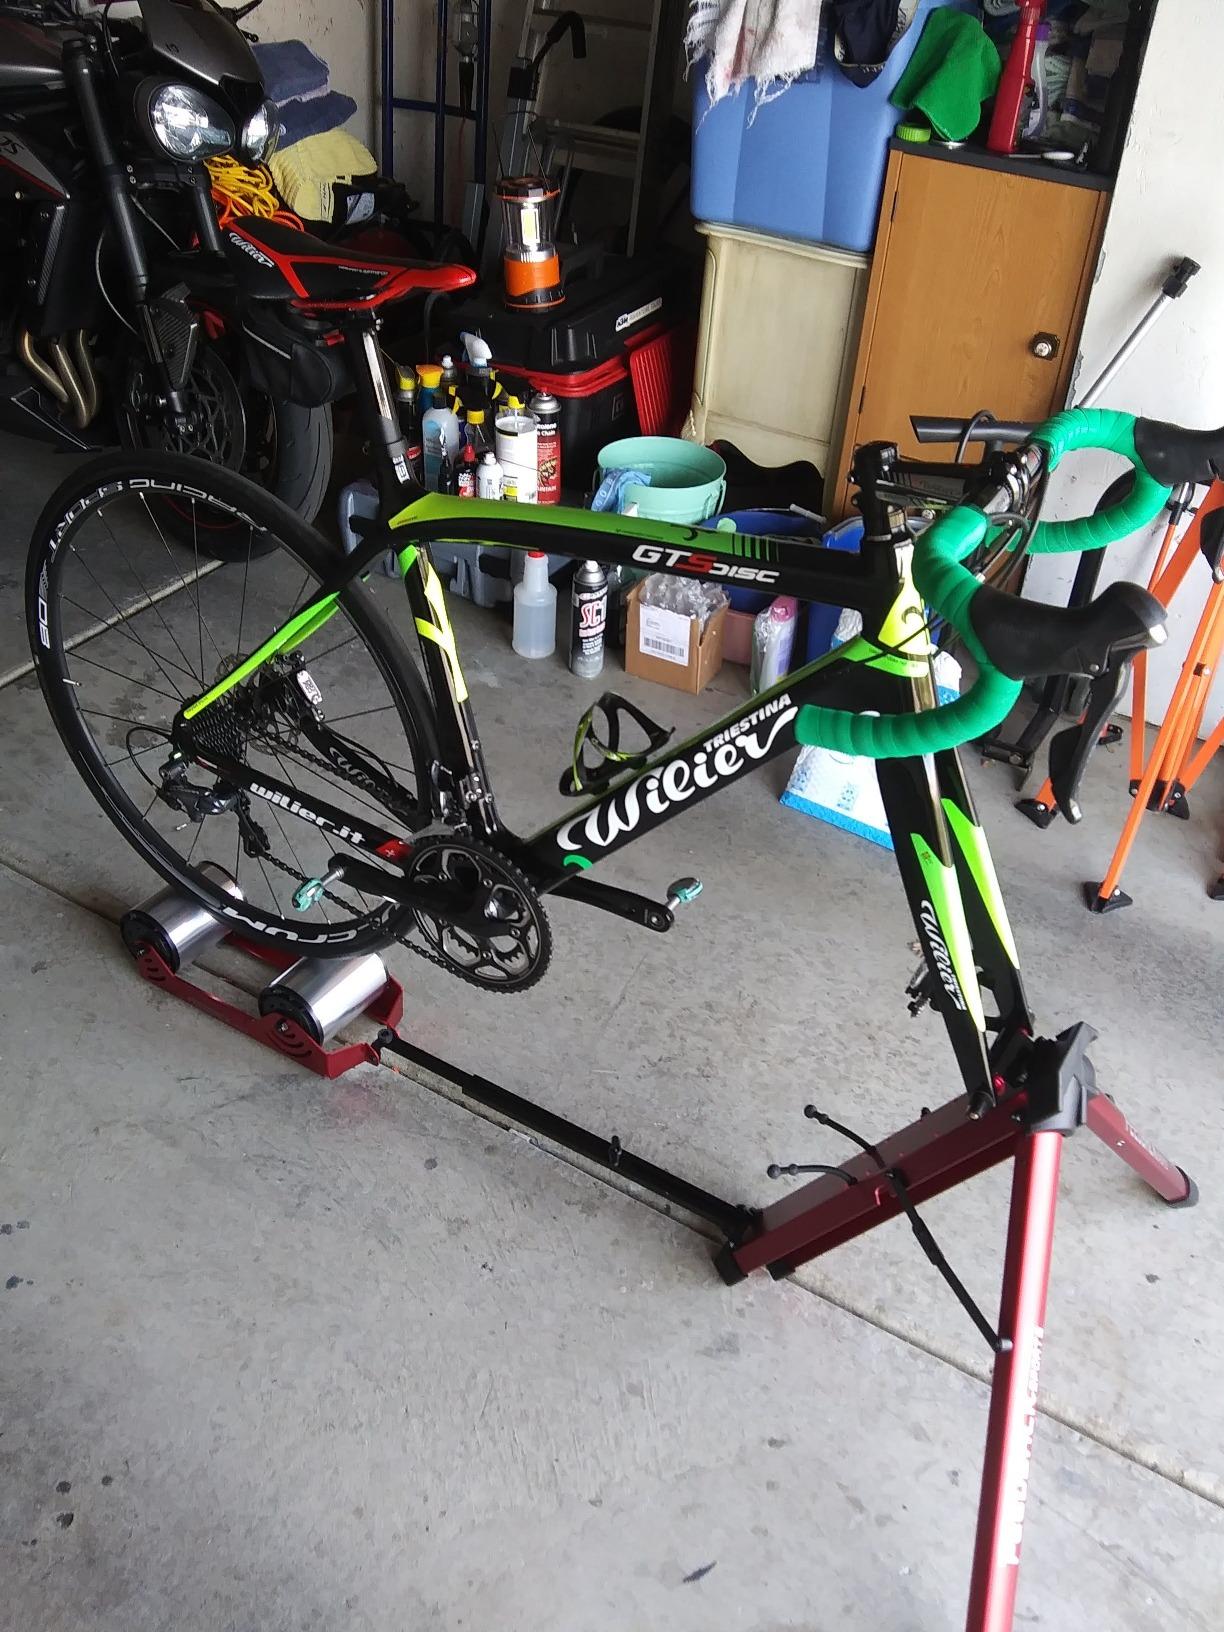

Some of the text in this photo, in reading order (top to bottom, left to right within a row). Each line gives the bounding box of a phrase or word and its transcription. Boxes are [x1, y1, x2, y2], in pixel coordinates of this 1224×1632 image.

[702, 693, 792, 753] TRIESTINA
[250, 782, 366, 844] wilier.it
[556, 706, 799, 851] Wilier
[920, 900, 963, 1010] Wilier
